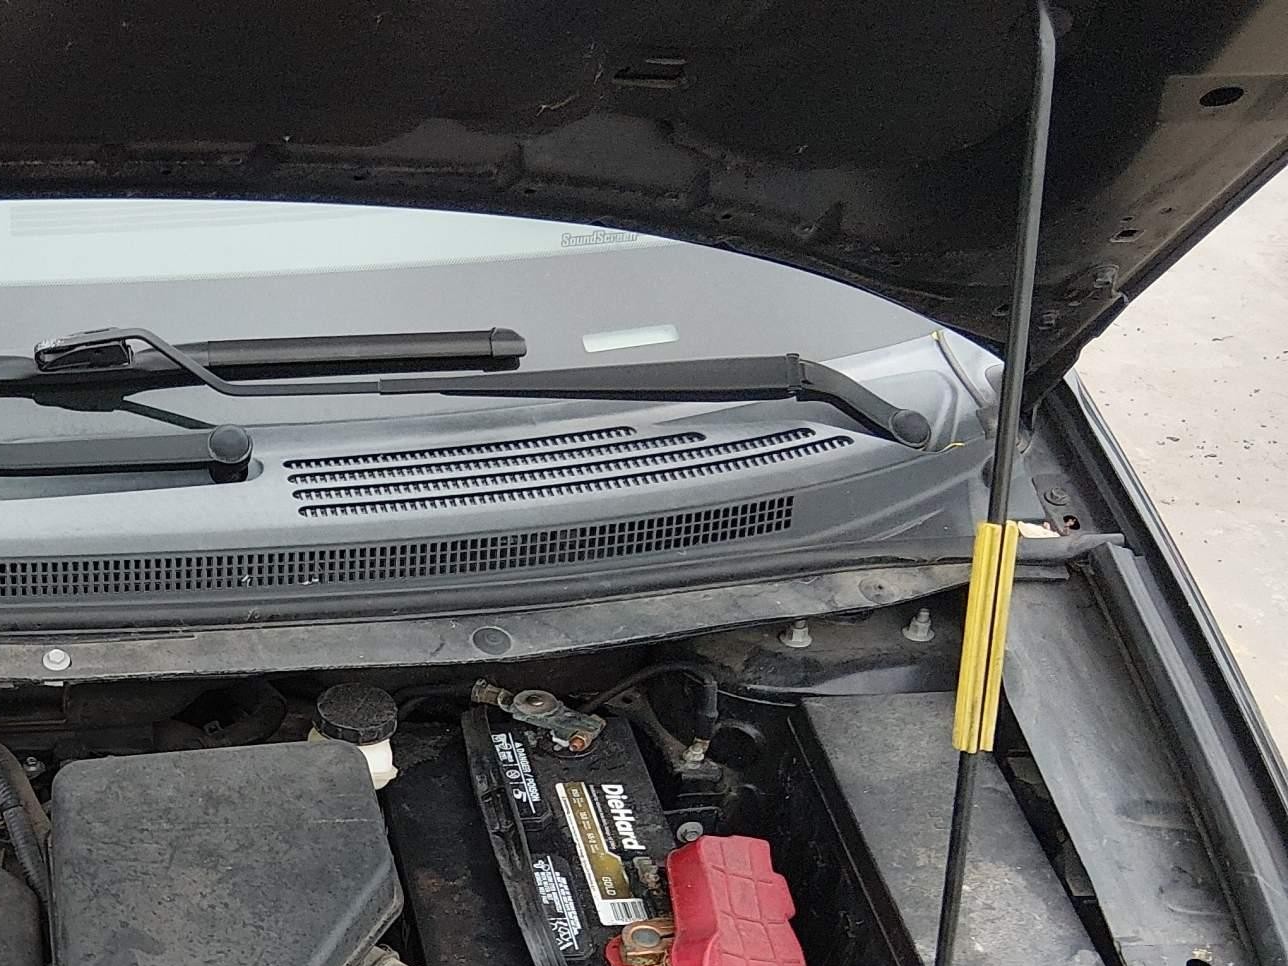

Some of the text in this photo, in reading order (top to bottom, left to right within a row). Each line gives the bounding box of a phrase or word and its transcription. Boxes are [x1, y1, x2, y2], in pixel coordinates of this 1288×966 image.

[516, 747, 532, 773] DANGER
[525, 778, 542, 802] POISON
[601, 784, 647, 850] DieHard
[602, 875, 617, 896] GOLD
